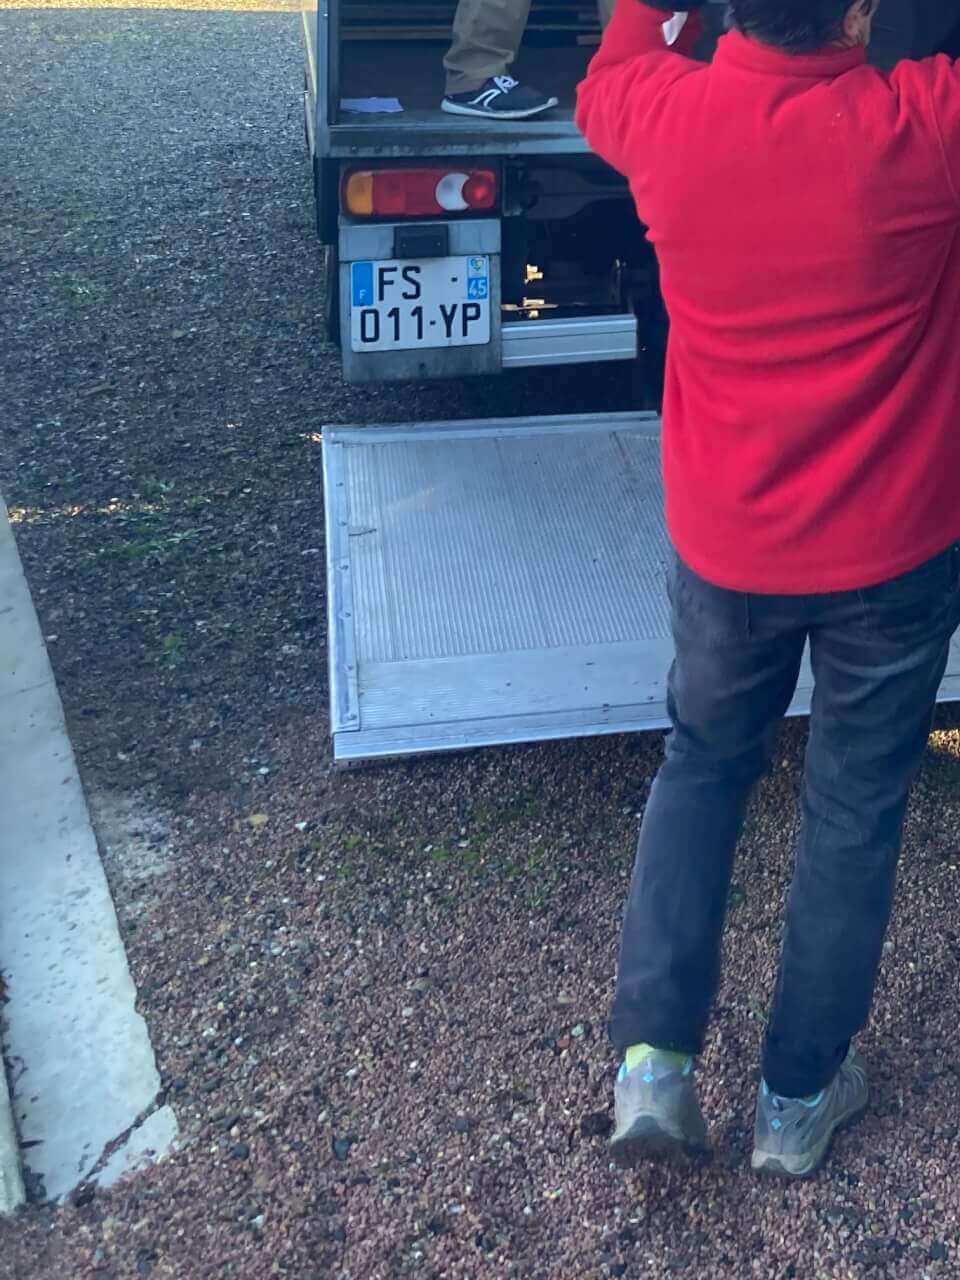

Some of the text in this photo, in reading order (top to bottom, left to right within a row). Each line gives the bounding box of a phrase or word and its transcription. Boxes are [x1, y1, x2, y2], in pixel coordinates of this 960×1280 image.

[359, 289, 367, 299] F
[378, 265, 421, 301] FS
[360, 302, 481, 342] 011-YP
